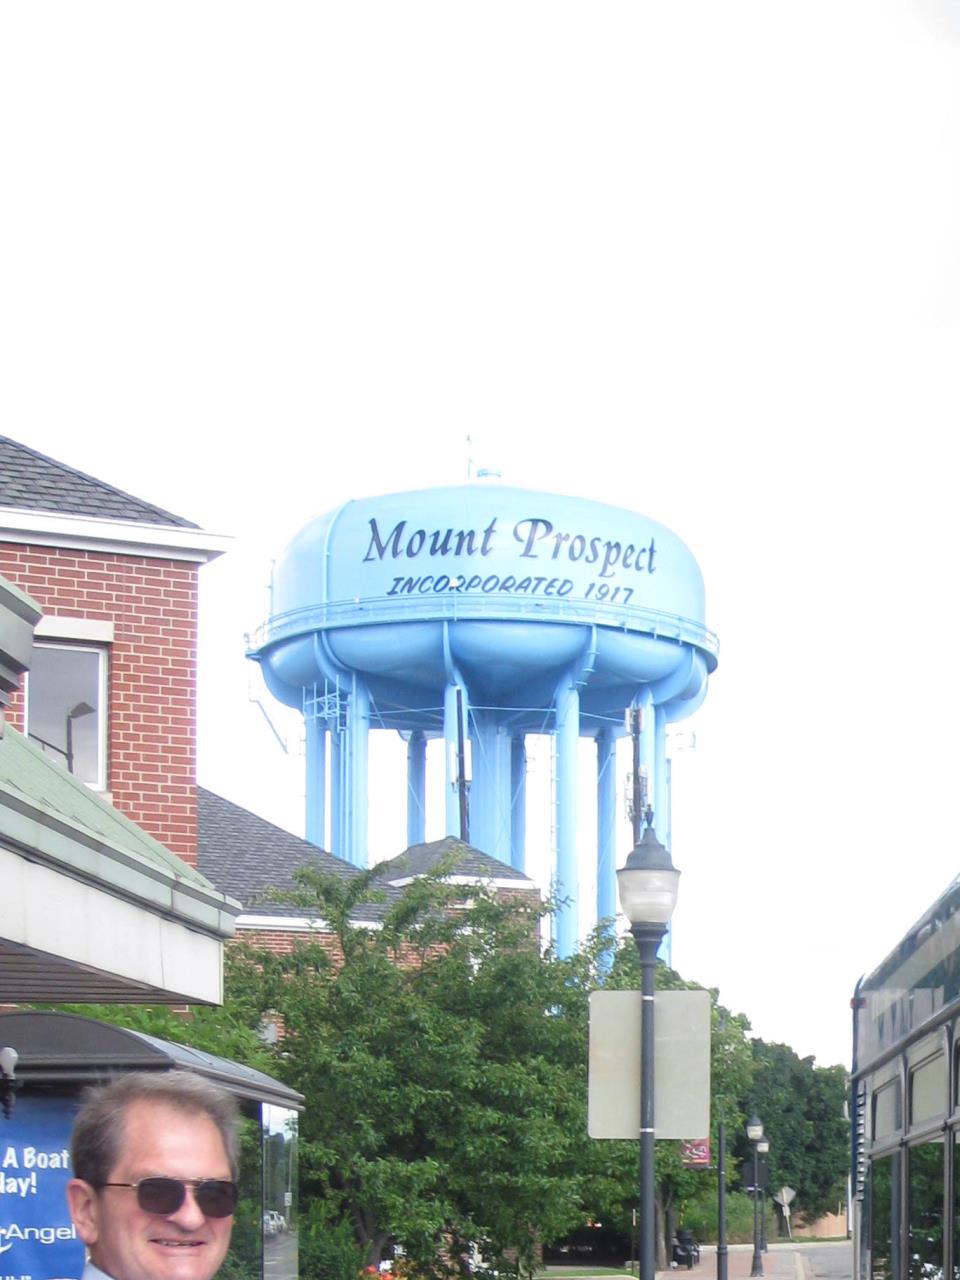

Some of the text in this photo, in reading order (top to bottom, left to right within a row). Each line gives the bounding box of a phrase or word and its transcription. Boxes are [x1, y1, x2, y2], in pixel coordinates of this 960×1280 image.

[362, 517, 657, 577] Mount Prospect
[386, 575, 634, 604] INCORPORATED 1917
[2, 1147, 70, 1169] A Boat
